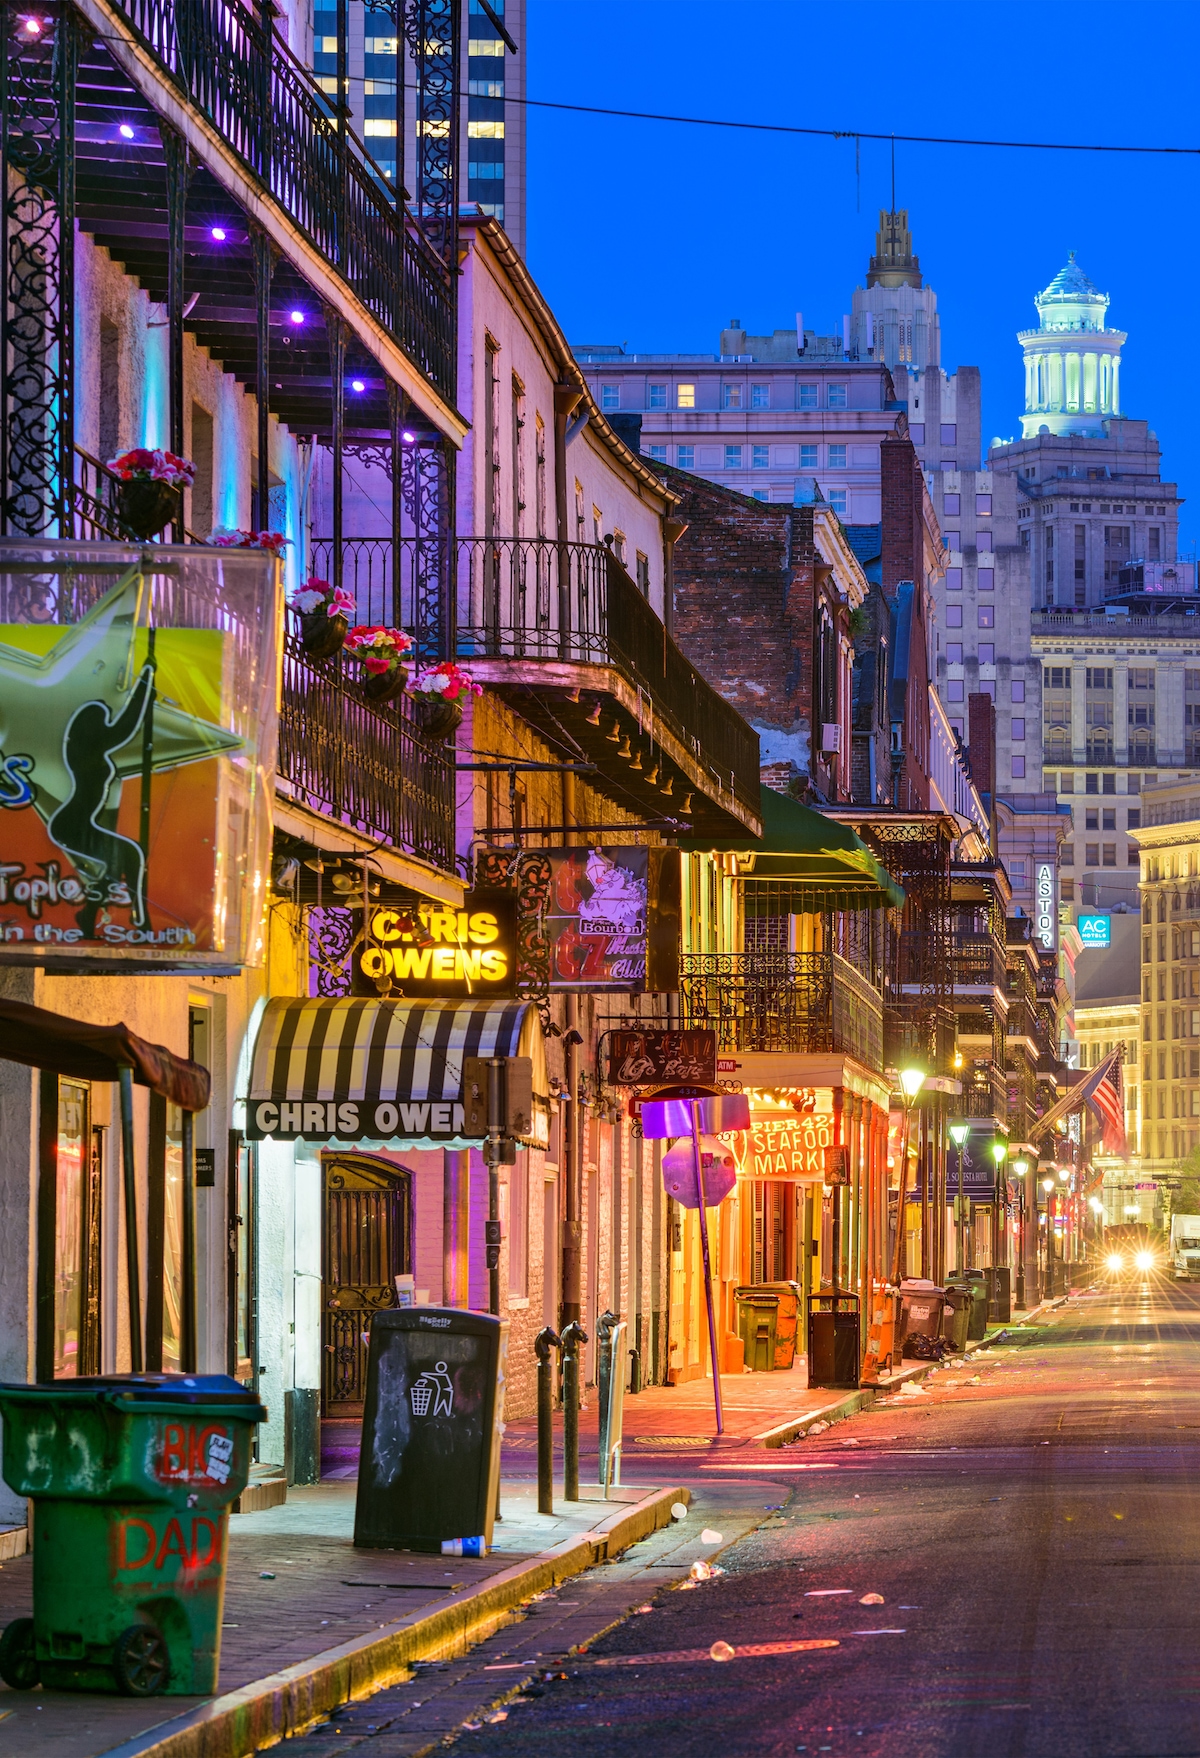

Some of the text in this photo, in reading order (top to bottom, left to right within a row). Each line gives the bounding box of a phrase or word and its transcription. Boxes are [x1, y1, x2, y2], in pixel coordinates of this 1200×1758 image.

[1038, 866, 1052, 949] ASTOR
[34, 922, 84, 943] the
[103, 922, 197, 944] South
[582, 921, 641, 934] Bourbon
[1082, 920, 1106, 932] AC
[359, 947, 508, 980] OWENS
[255, 1102, 464, 1133] CHRIS OWEN
[750, 1120, 800, 1134] PIER
[754, 1127, 829, 1153] SEAFOO
[754, 1151, 826, 1175] MARK
[418, 1315, 452, 1326] BigBelly
